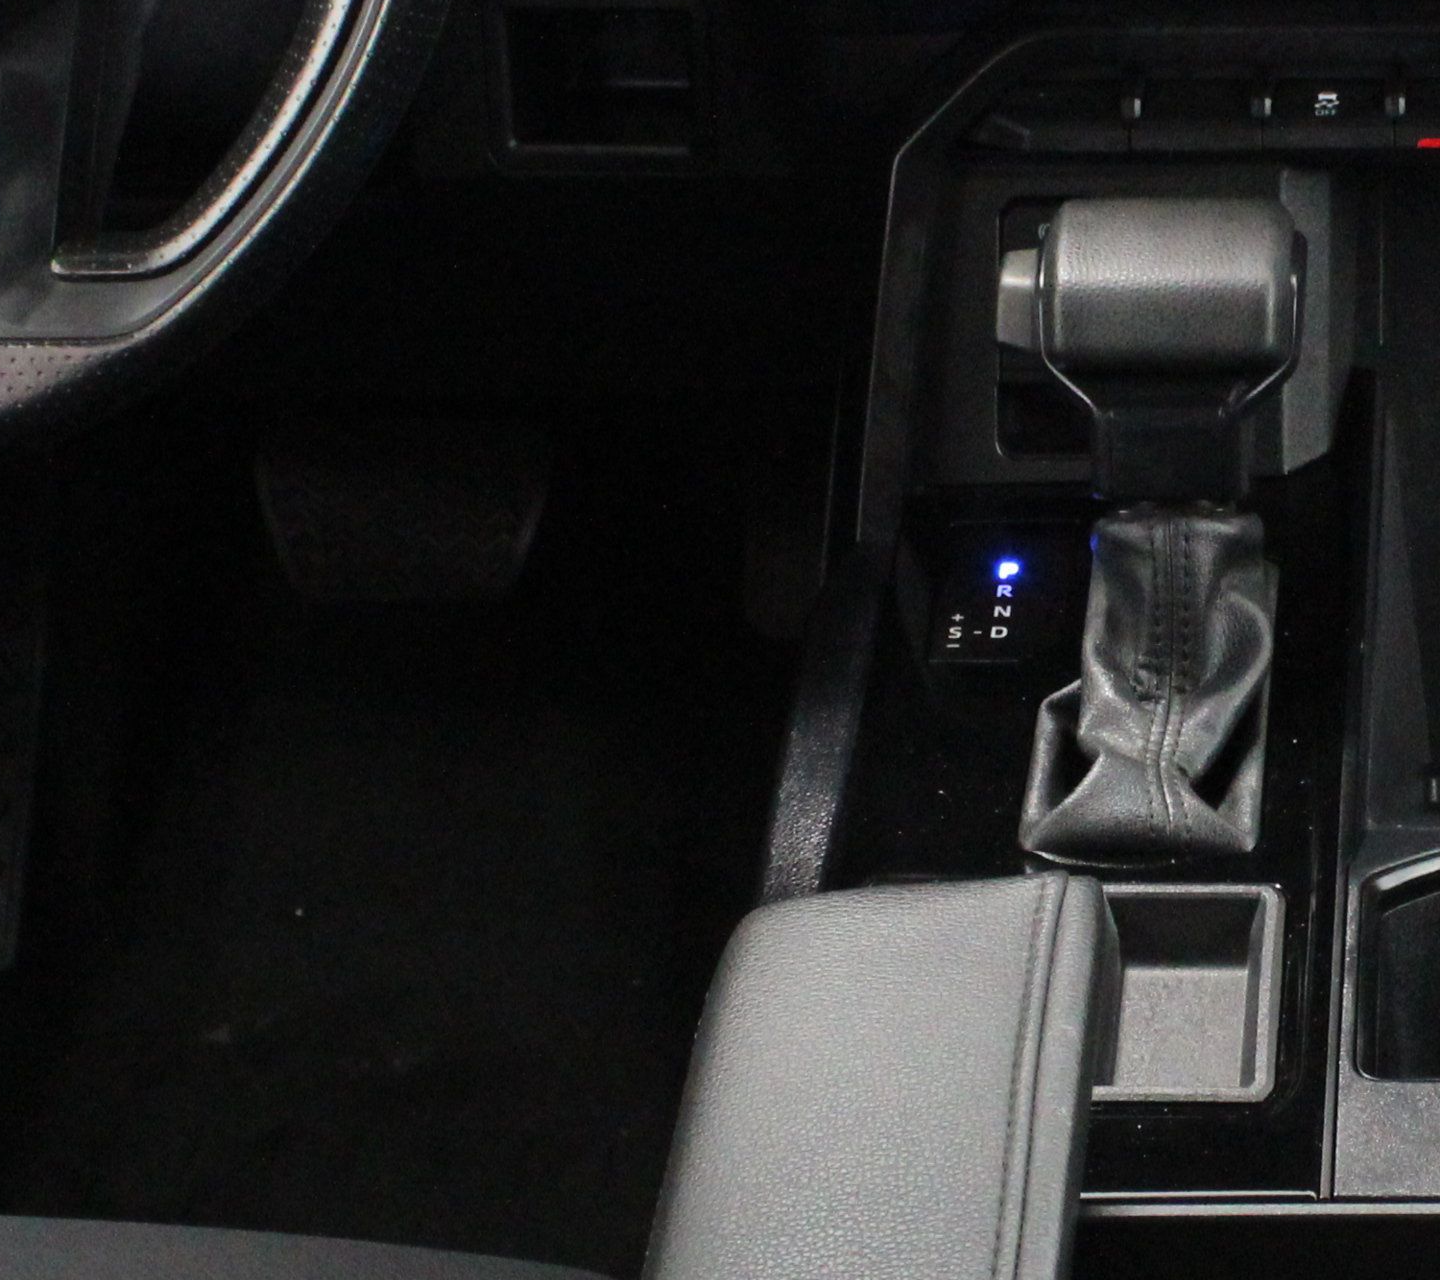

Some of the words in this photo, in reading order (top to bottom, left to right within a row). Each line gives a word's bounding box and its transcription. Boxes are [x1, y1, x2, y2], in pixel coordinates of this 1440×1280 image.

[997, 561, 1020, 581] P
[996, 584, 1013, 598] R
[993, 605, 1012, 618] N
[947, 626, 963, 639] S
[990, 626, 1008, 639] D
